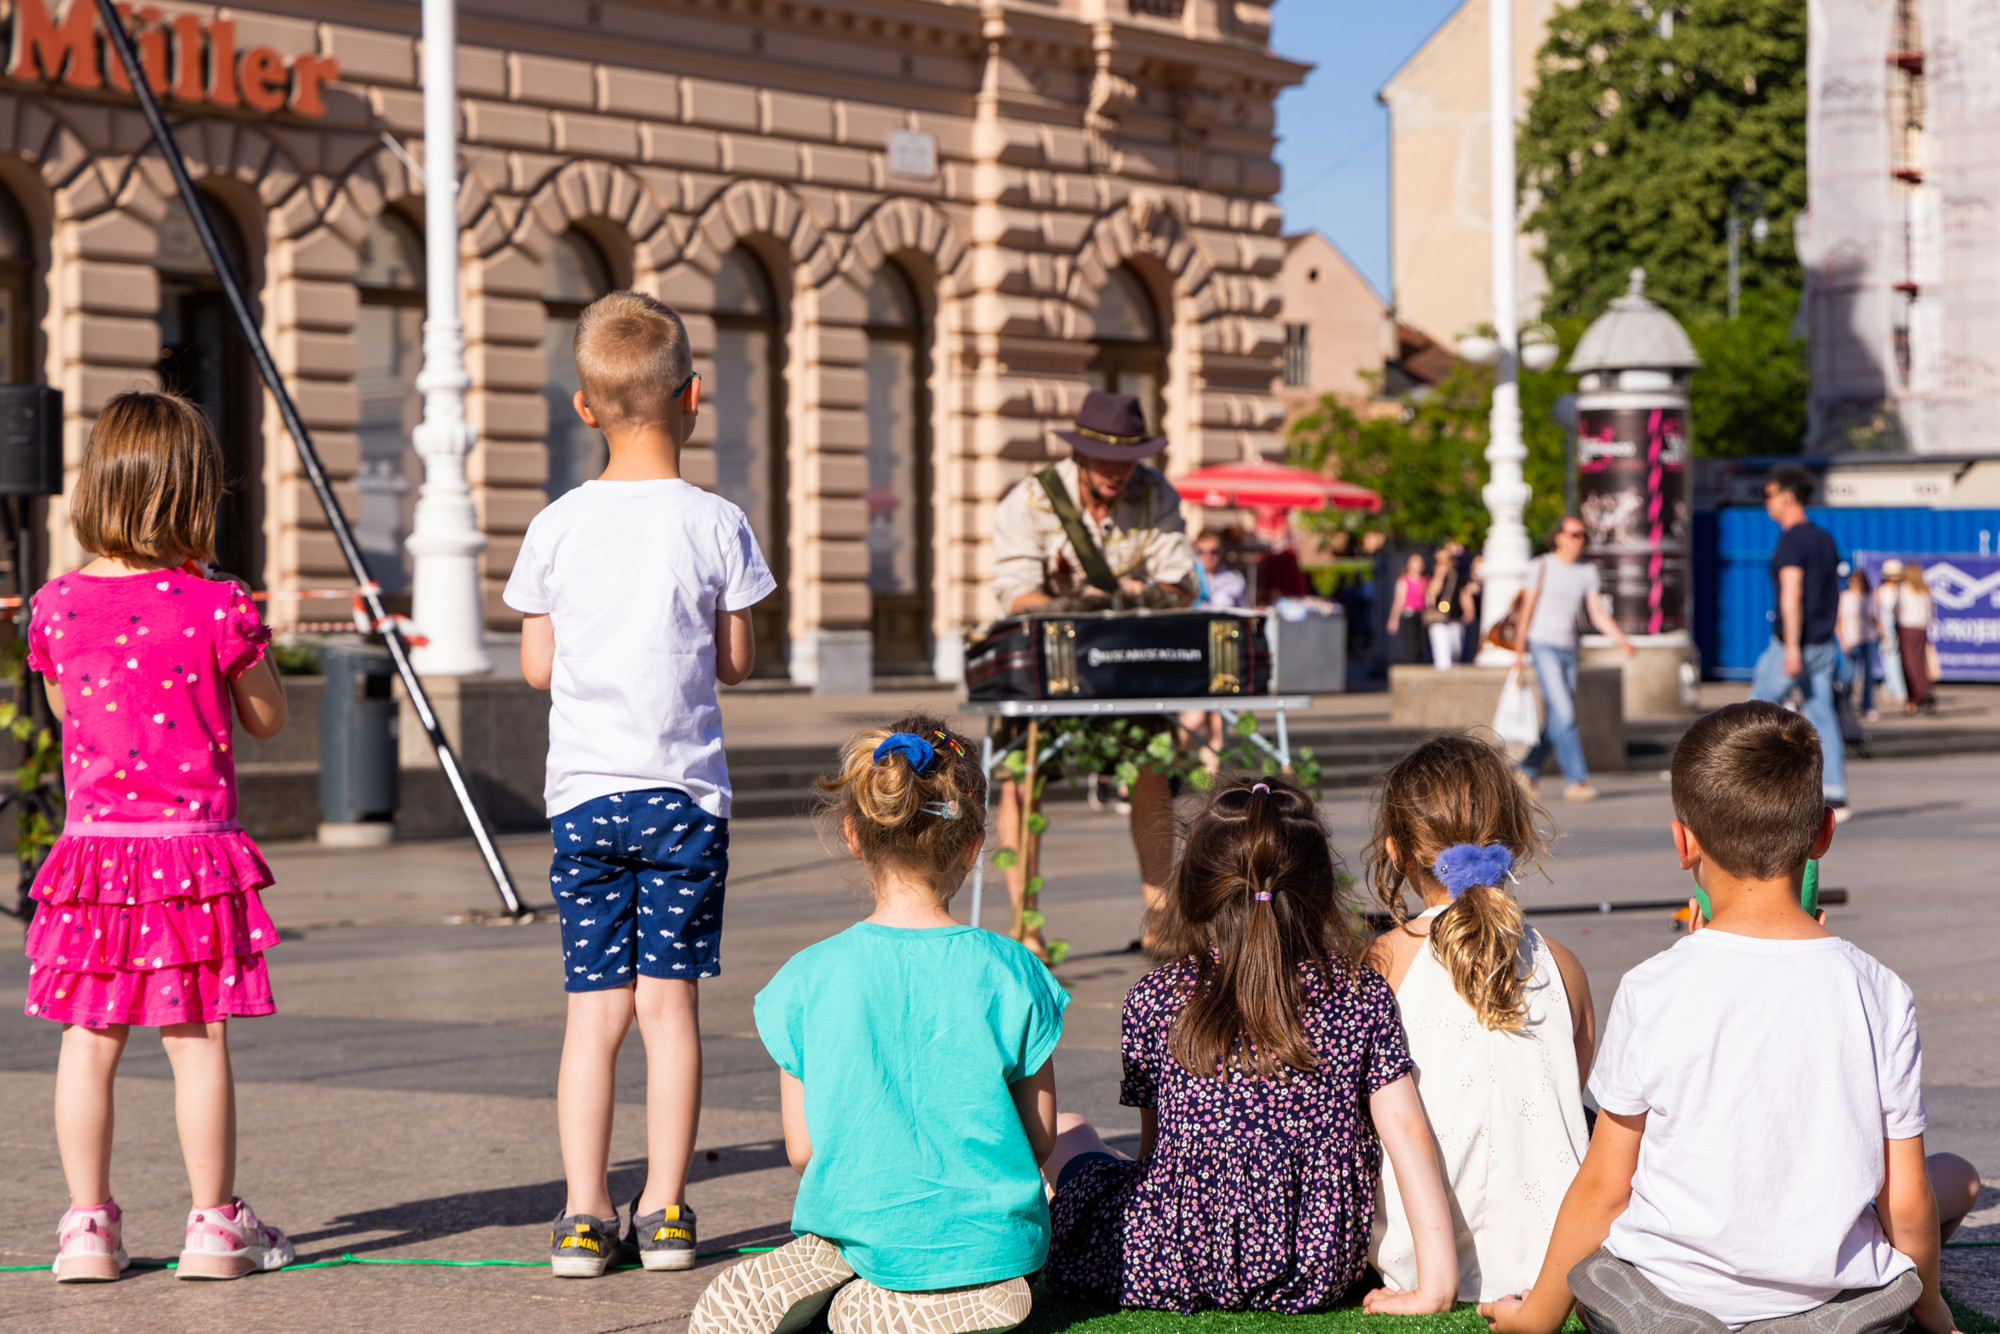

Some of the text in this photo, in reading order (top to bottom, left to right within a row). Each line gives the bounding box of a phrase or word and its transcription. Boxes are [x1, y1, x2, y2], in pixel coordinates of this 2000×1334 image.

[8, 0, 339, 116] Müller
[653, 1226, 692, 1243] BATMAN
[559, 1235, 600, 1254] BATMAN
